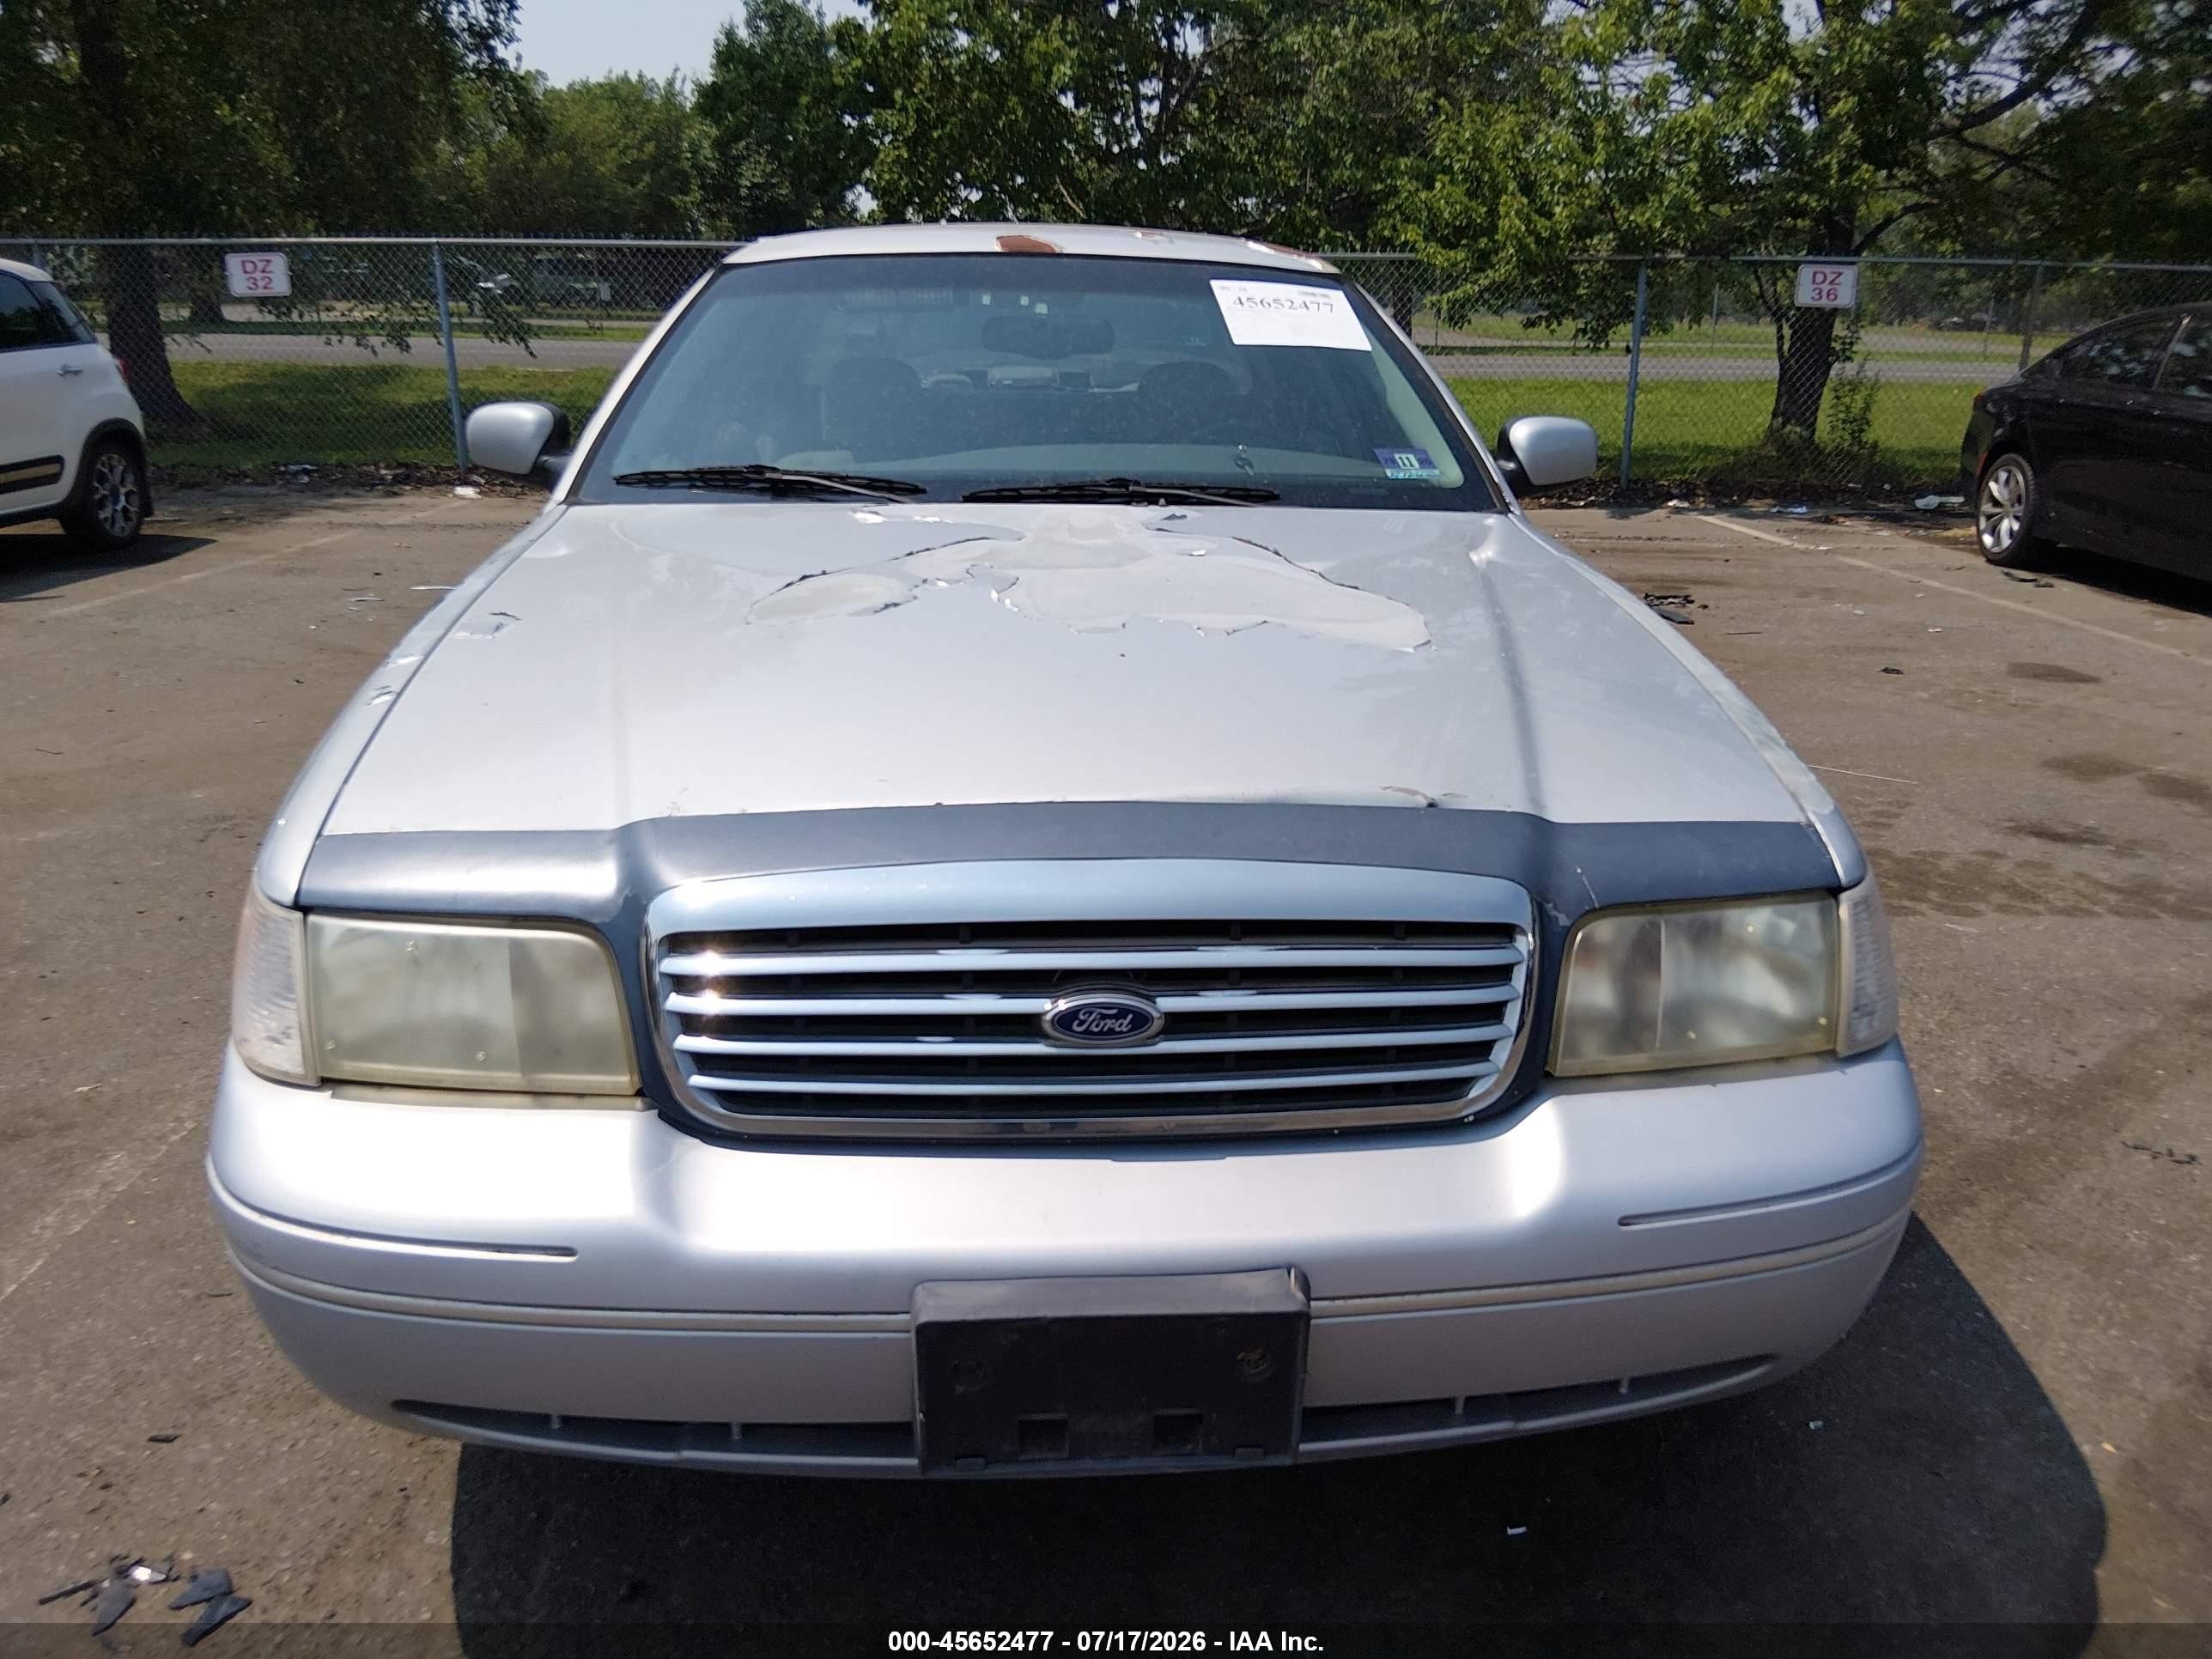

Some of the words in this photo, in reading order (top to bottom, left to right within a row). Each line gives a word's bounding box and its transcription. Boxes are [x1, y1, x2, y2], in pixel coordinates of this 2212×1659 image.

[241, 259, 274, 274] DZ
[246, 276, 274, 290] 32
[1812, 270, 1844, 285] DZ
[1811, 287, 1838, 302] 36
[1232, 295, 1334, 313] 45652477
[1398, 456, 1415, 468] 11
[1072, 1006, 1134, 1033] Ford
